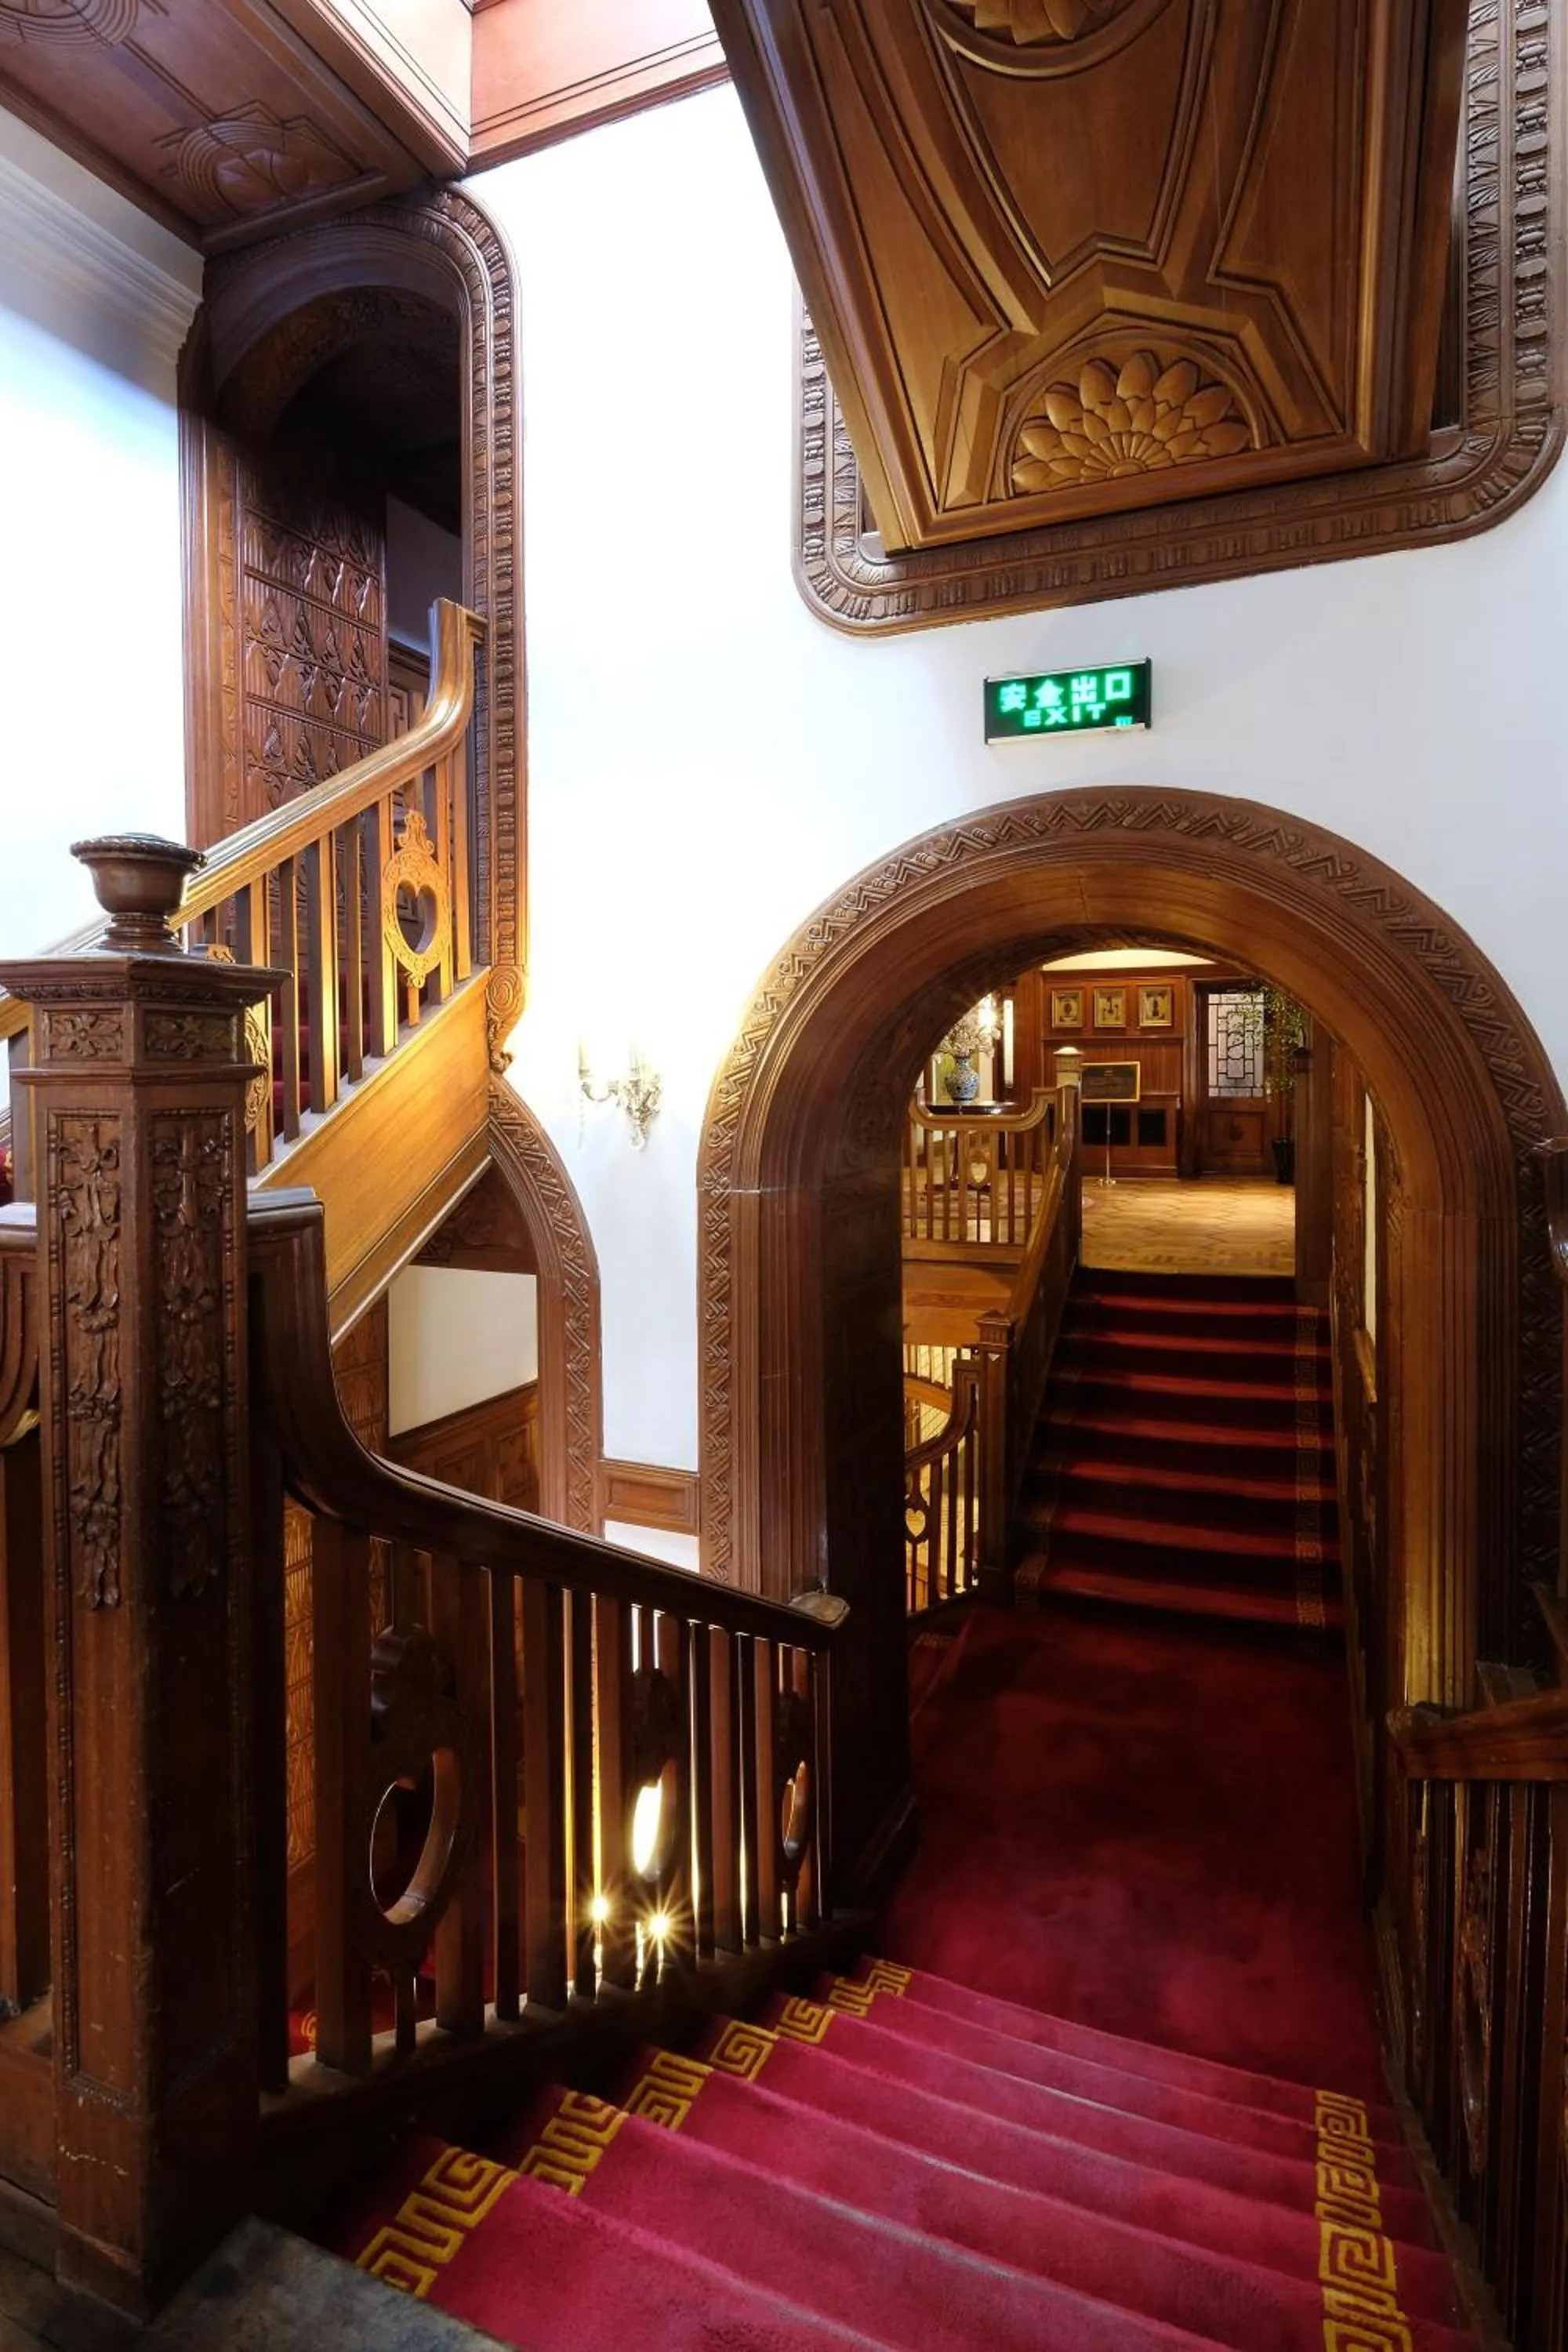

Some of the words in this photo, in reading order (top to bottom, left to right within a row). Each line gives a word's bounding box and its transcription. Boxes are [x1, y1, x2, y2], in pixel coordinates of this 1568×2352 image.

[1000, 671, 1131, 713] 安全出口
[1024, 702, 1106, 727] EXIT
